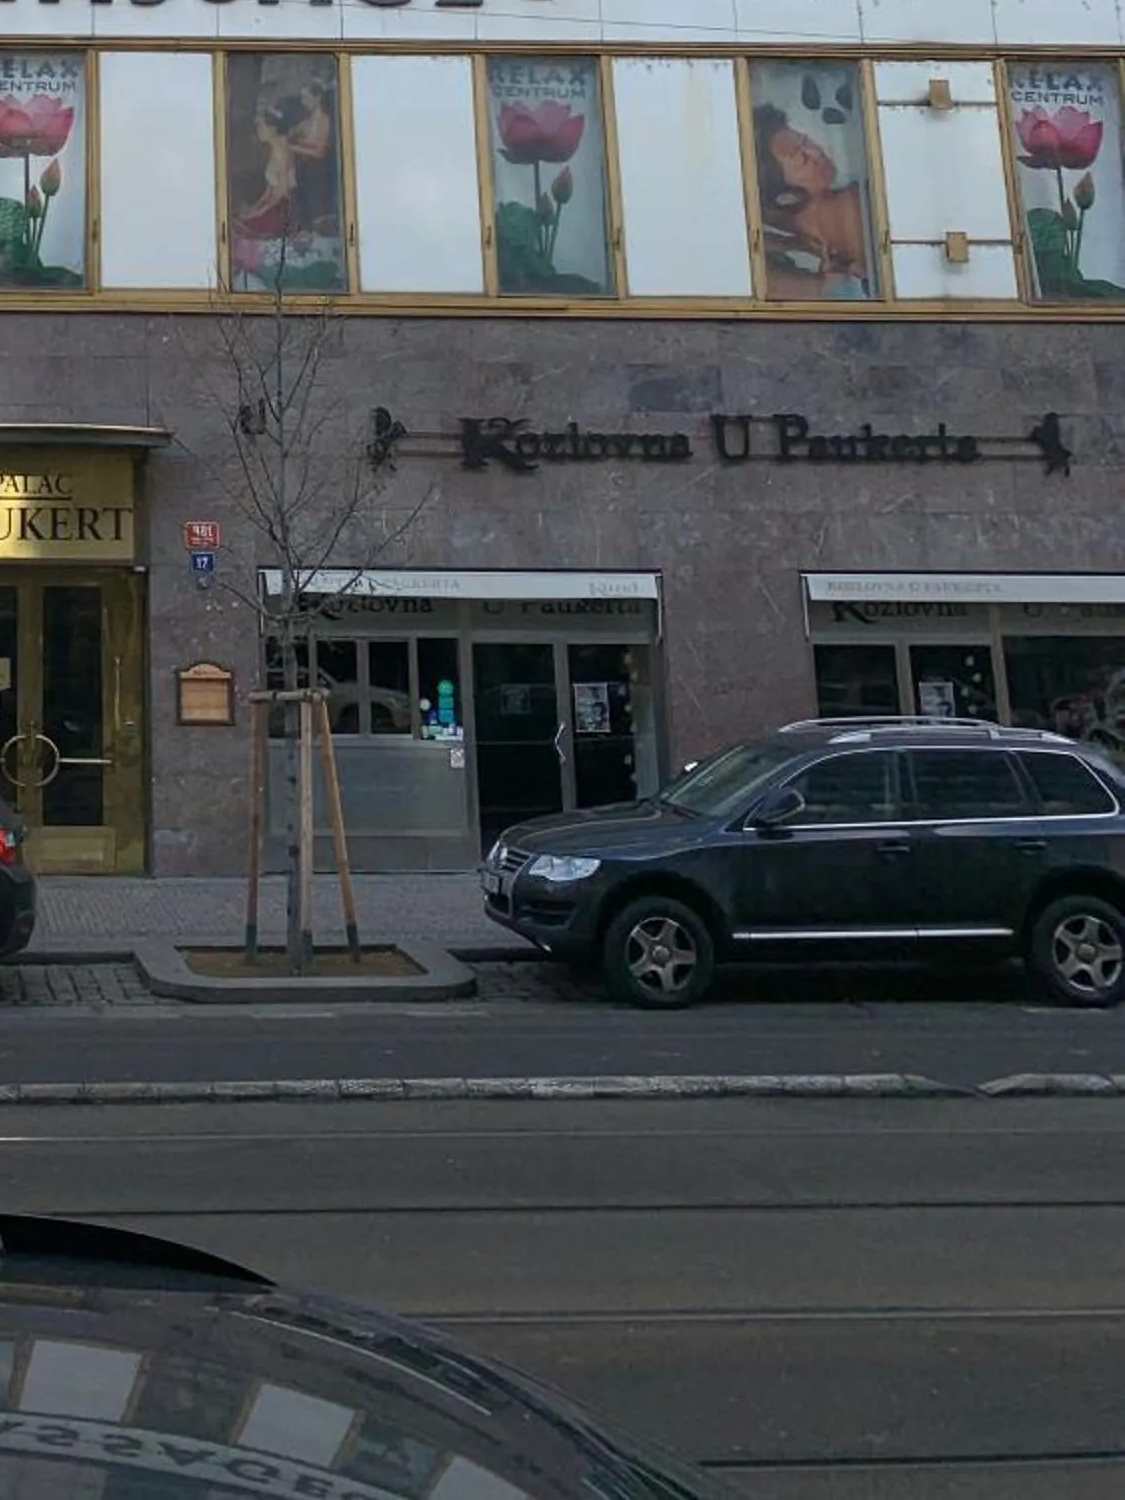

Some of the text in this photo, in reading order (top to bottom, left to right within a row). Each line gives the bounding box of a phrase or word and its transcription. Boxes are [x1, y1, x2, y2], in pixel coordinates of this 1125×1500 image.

[487, 64, 588, 86] RELAX
[1009, 68, 1104, 92] RELAX
[1010, 91, 1104, 106] CENTRUM
[459, 413, 982, 471] Kozlovna U Paukerta
